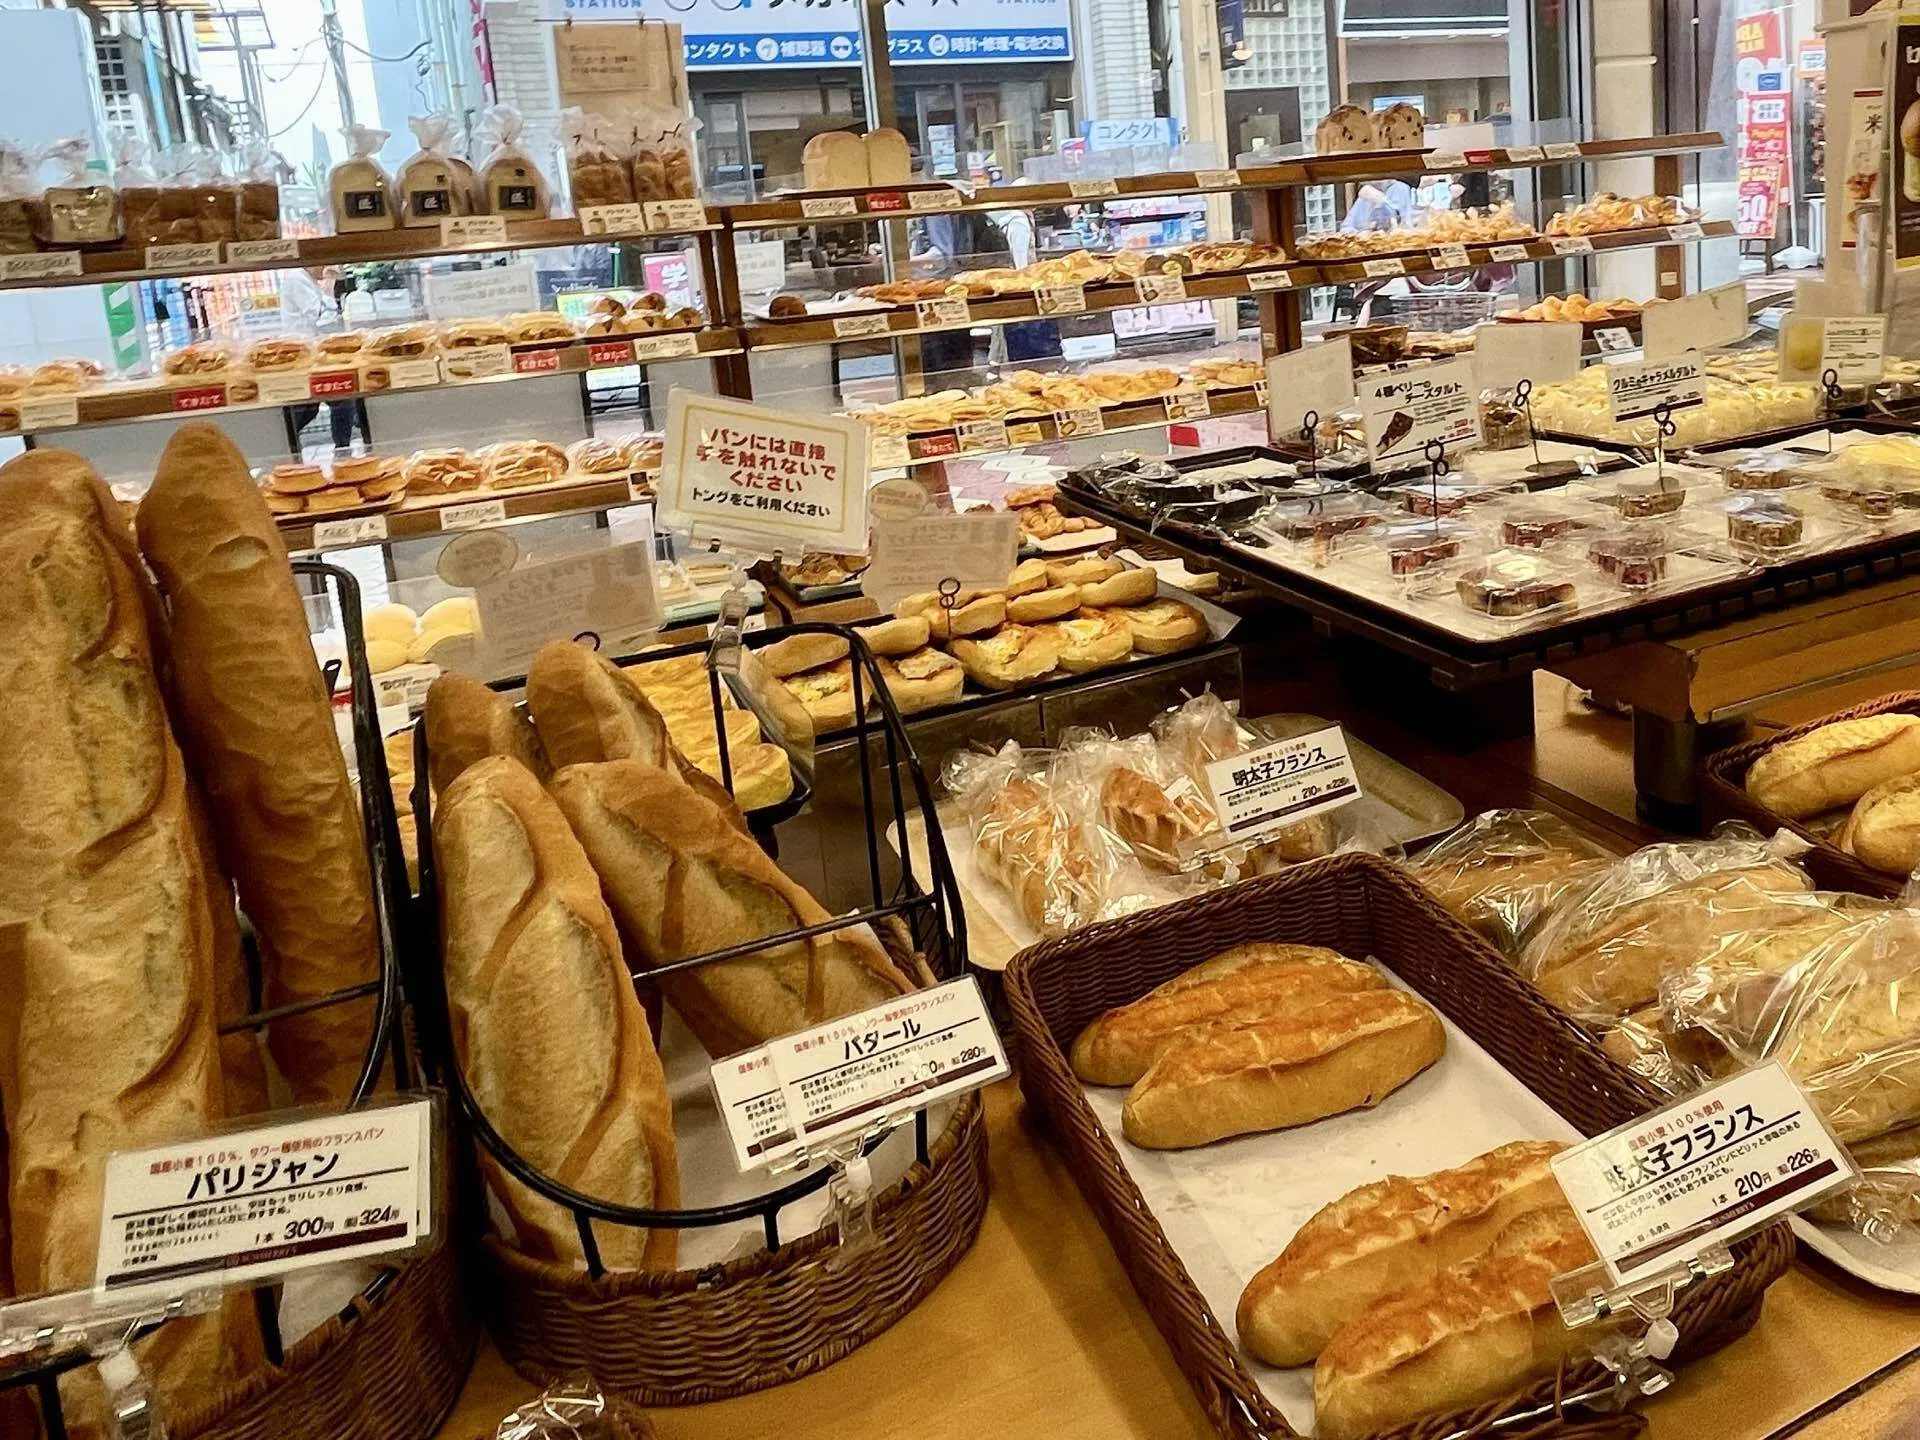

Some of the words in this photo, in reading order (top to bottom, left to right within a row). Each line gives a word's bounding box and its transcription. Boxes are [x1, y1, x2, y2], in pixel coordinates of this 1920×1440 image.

[1097, 121, 1162, 140] コンタクト
[711, 428, 825, 461] パンには直接
[696, 445, 837, 481] 手を触れないで
[729, 470, 803, 493] ください
[692, 487, 831, 517] トングをご利用ください
[1232, 746, 1327, 787] 明太子フランス
[844, 1019, 921, 1060] バタール
[187, 1153, 339, 1200] パリジャン
[1734, 1170, 1773, 1198] 210円
[283, 1216, 334, 1240] 300円
